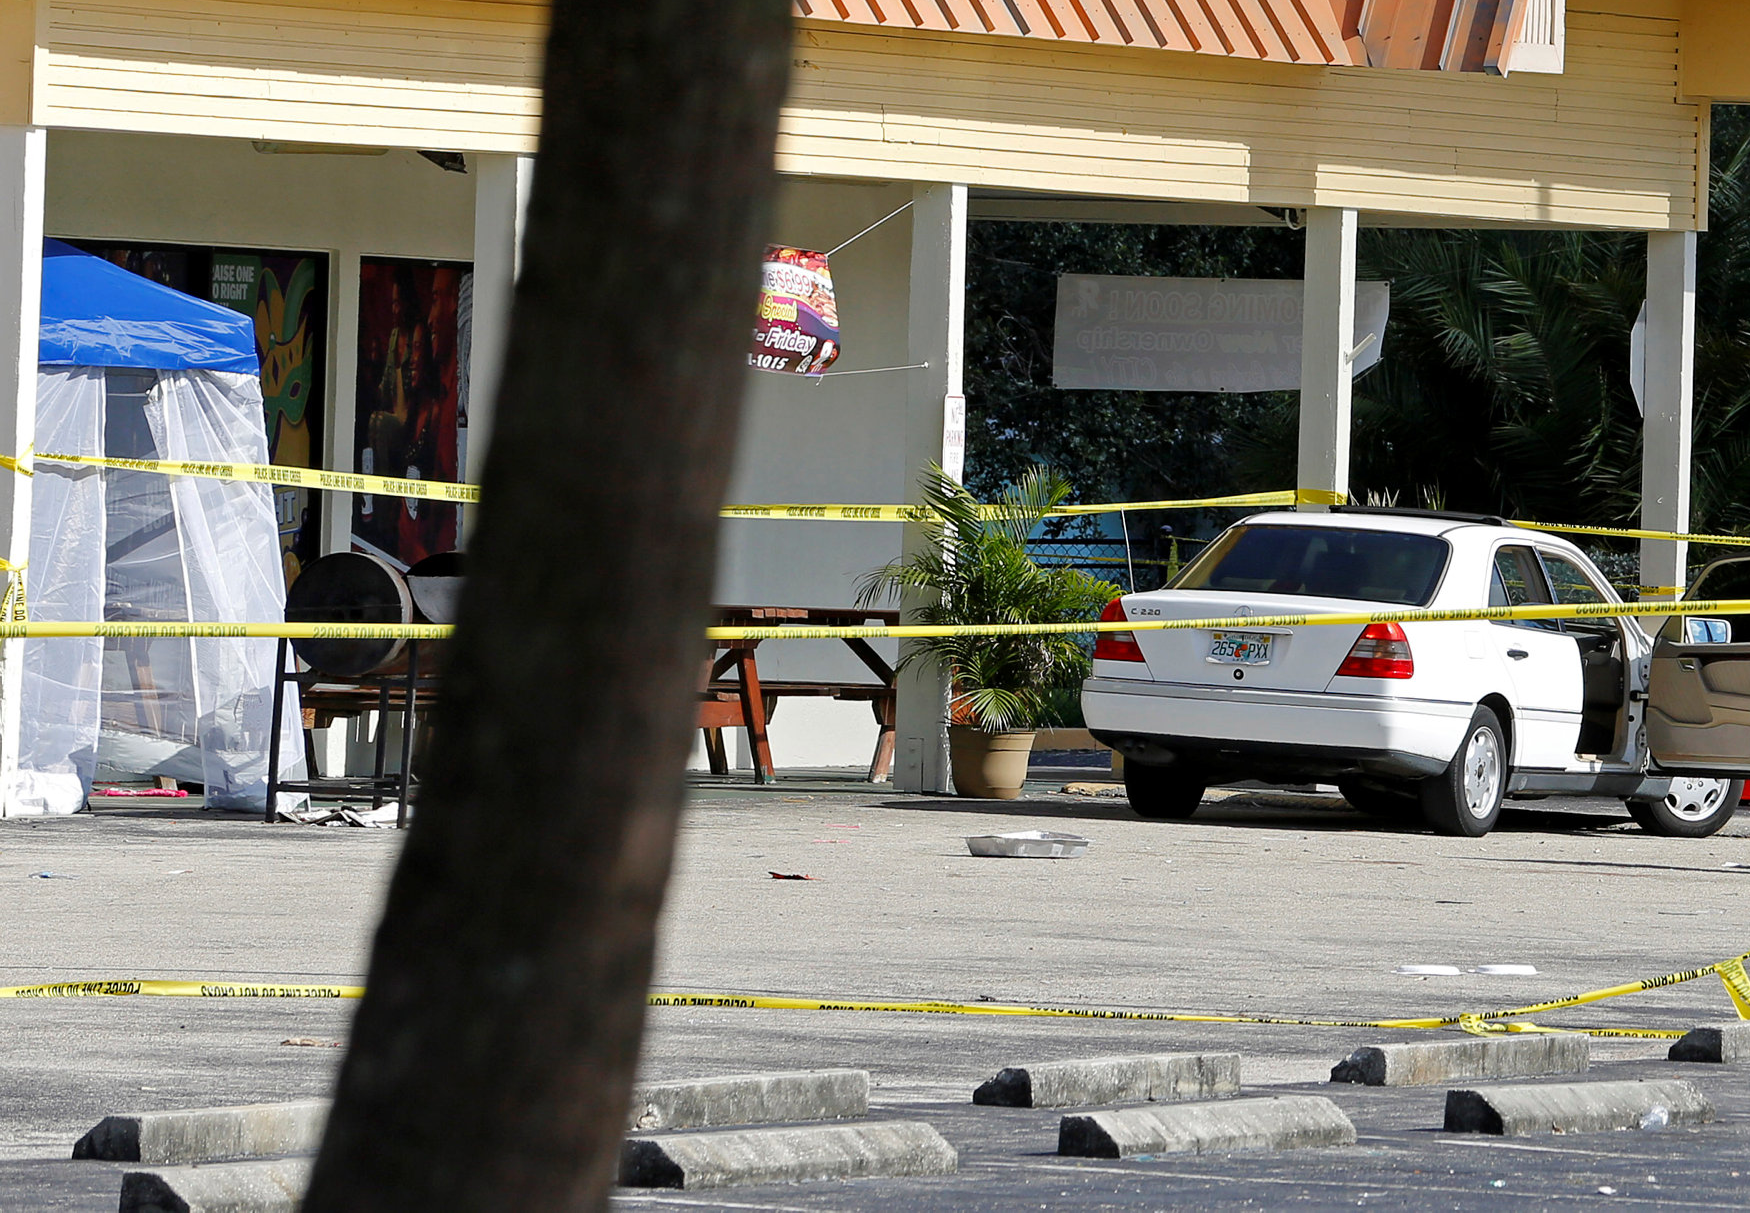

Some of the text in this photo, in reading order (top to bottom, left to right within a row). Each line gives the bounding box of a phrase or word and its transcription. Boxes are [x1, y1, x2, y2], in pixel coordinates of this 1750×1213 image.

[212, 265, 255, 282] AISE ONE
[221, 283, 248, 300] RIGHT
[761, 294, 798, 322] Special
[764, 327, 817, 356] Friday
[1140, 608, 1161, 616] 220
[1211, 641, 1268, 659] 265 PXX
